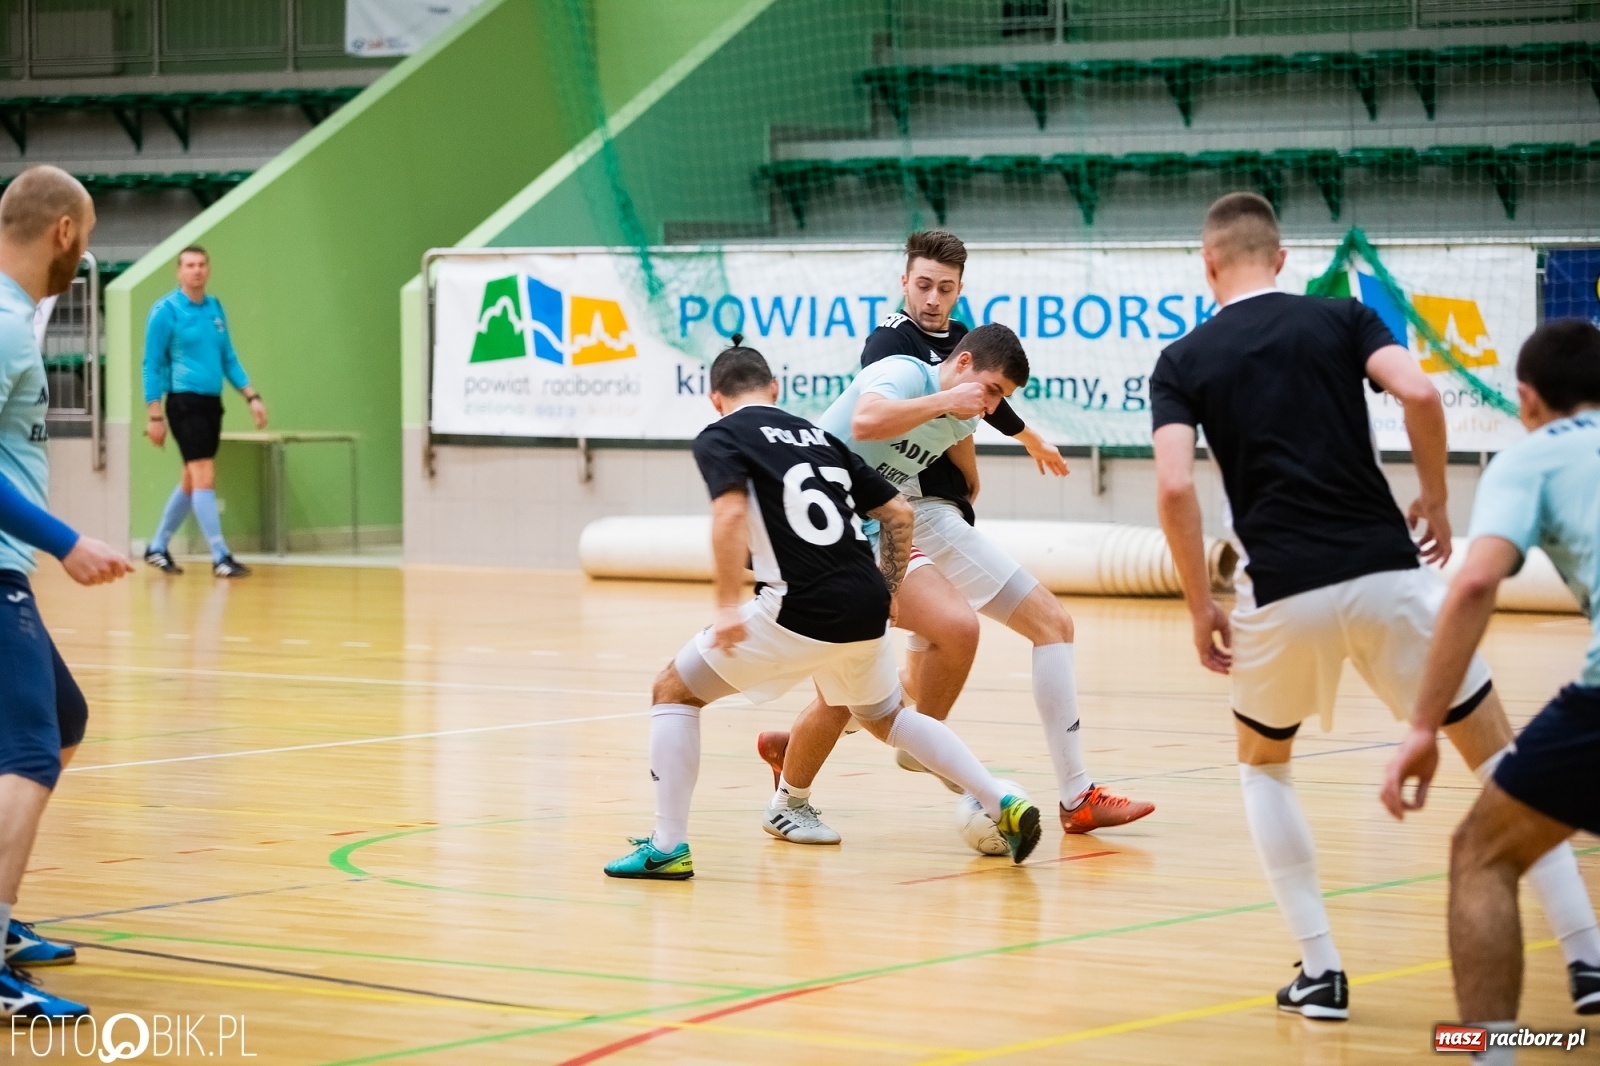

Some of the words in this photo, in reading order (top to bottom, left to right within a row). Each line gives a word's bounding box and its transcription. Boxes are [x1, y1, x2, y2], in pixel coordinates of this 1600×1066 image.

[678, 294, 888, 338] POWIAT
[463, 371, 532, 398] powiat
[542, 372, 641, 397] raciborski
[759, 426, 831, 447] POLAK
[782, 462, 868, 546] 67
